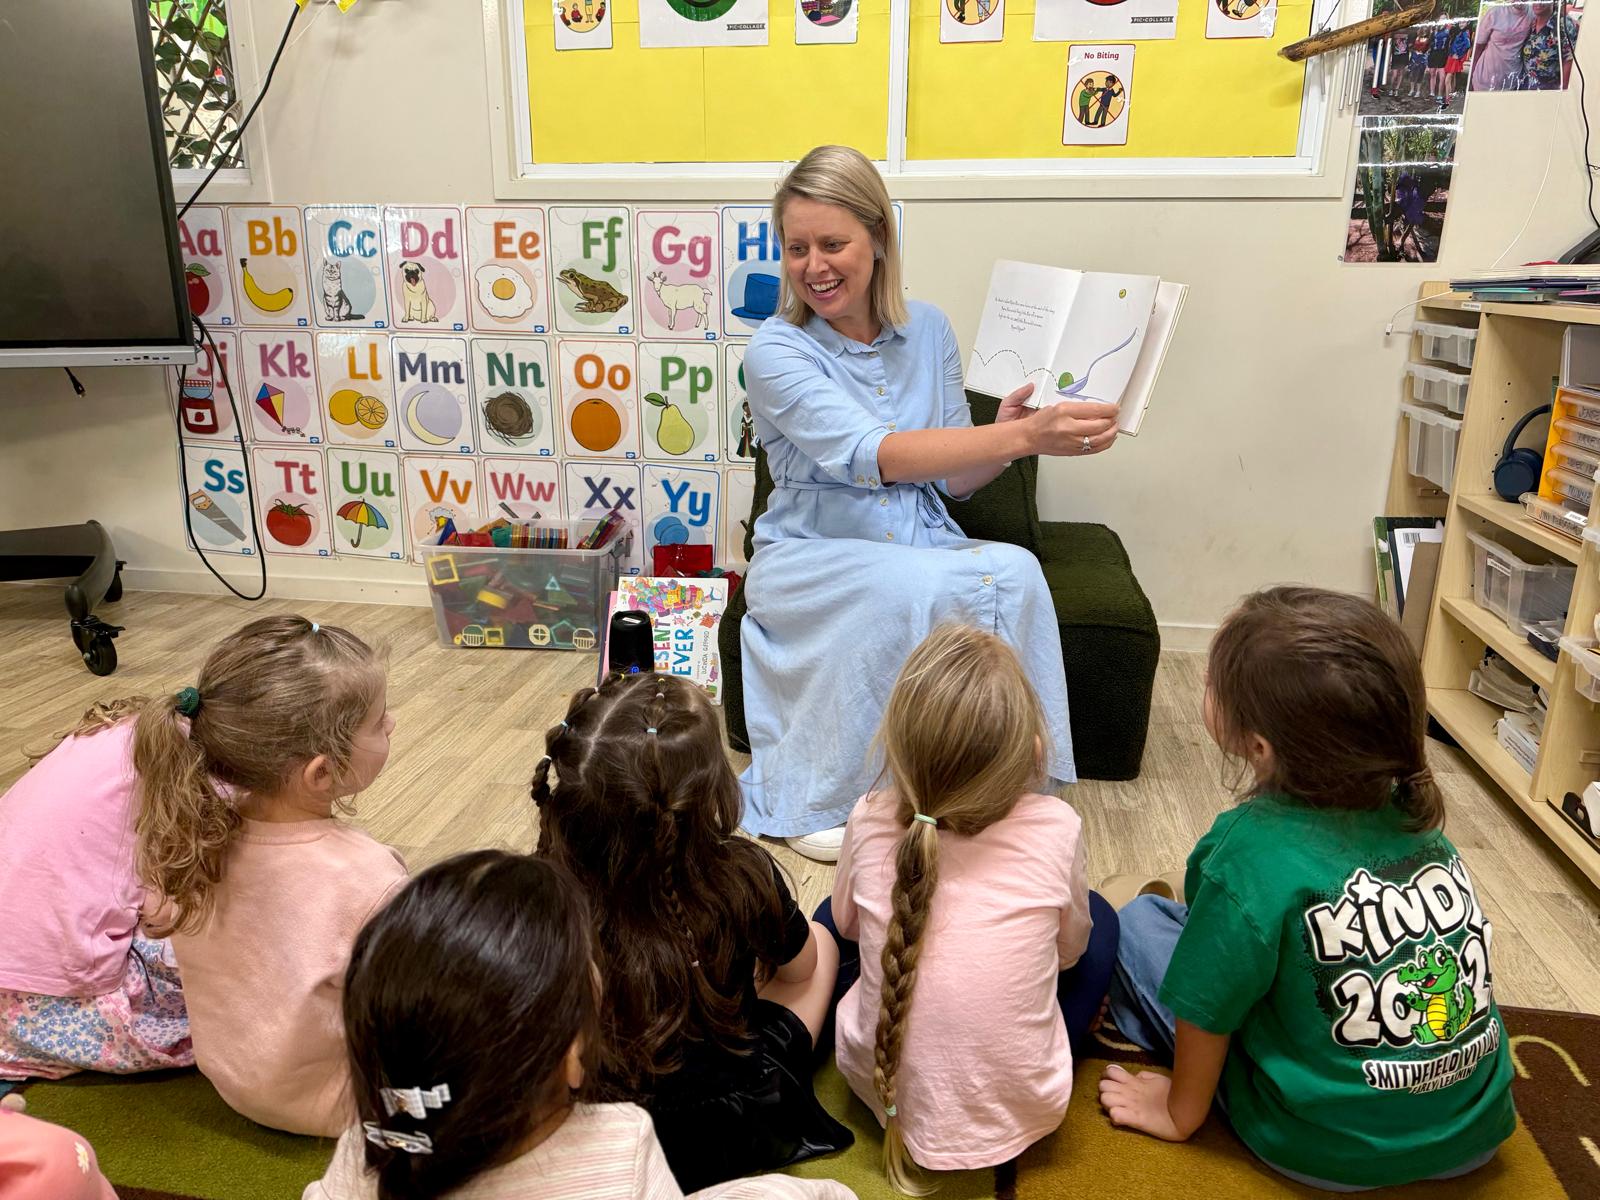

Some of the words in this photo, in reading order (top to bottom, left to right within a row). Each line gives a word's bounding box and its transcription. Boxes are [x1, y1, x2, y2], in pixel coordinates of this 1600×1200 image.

[1084, 52, 1095, 60] No
[1096, 51, 1120, 61] Biting
[178, 219, 222, 257] Aa
[247, 216, 298, 257] Bb
[327, 219, 378, 258] Cc
[400, 218, 459, 260] Dd
[493, 221, 541, 259] Ee
[581, 216, 623, 272] Ff
[651, 225, 713, 278] Gg
[196, 342, 228, 389] Jj
[259, 340, 311, 379] Kk
[347, 343, 383, 381] Ll
[399, 352, 465, 384] Mm
[486, 352, 545, 388] Nn
[574, 354, 631, 391] Oo
[660, 356, 713, 404] Pp
[203, 459, 245, 494] Ss
[274, 460, 318, 495] Tt
[341, 461, 395, 497] Uu
[420, 470, 473, 505] Vv
[490, 472, 556, 502] Ww
[583, 476, 636, 510] Xx
[661, 479, 711, 527] Yy
[654, 618, 671, 674] ESENT
[672, 628, 694, 676] EVER
[1331, 920, 1492, 1048] 202
[1362, 1049, 1461, 1090] SMITHFIELD
